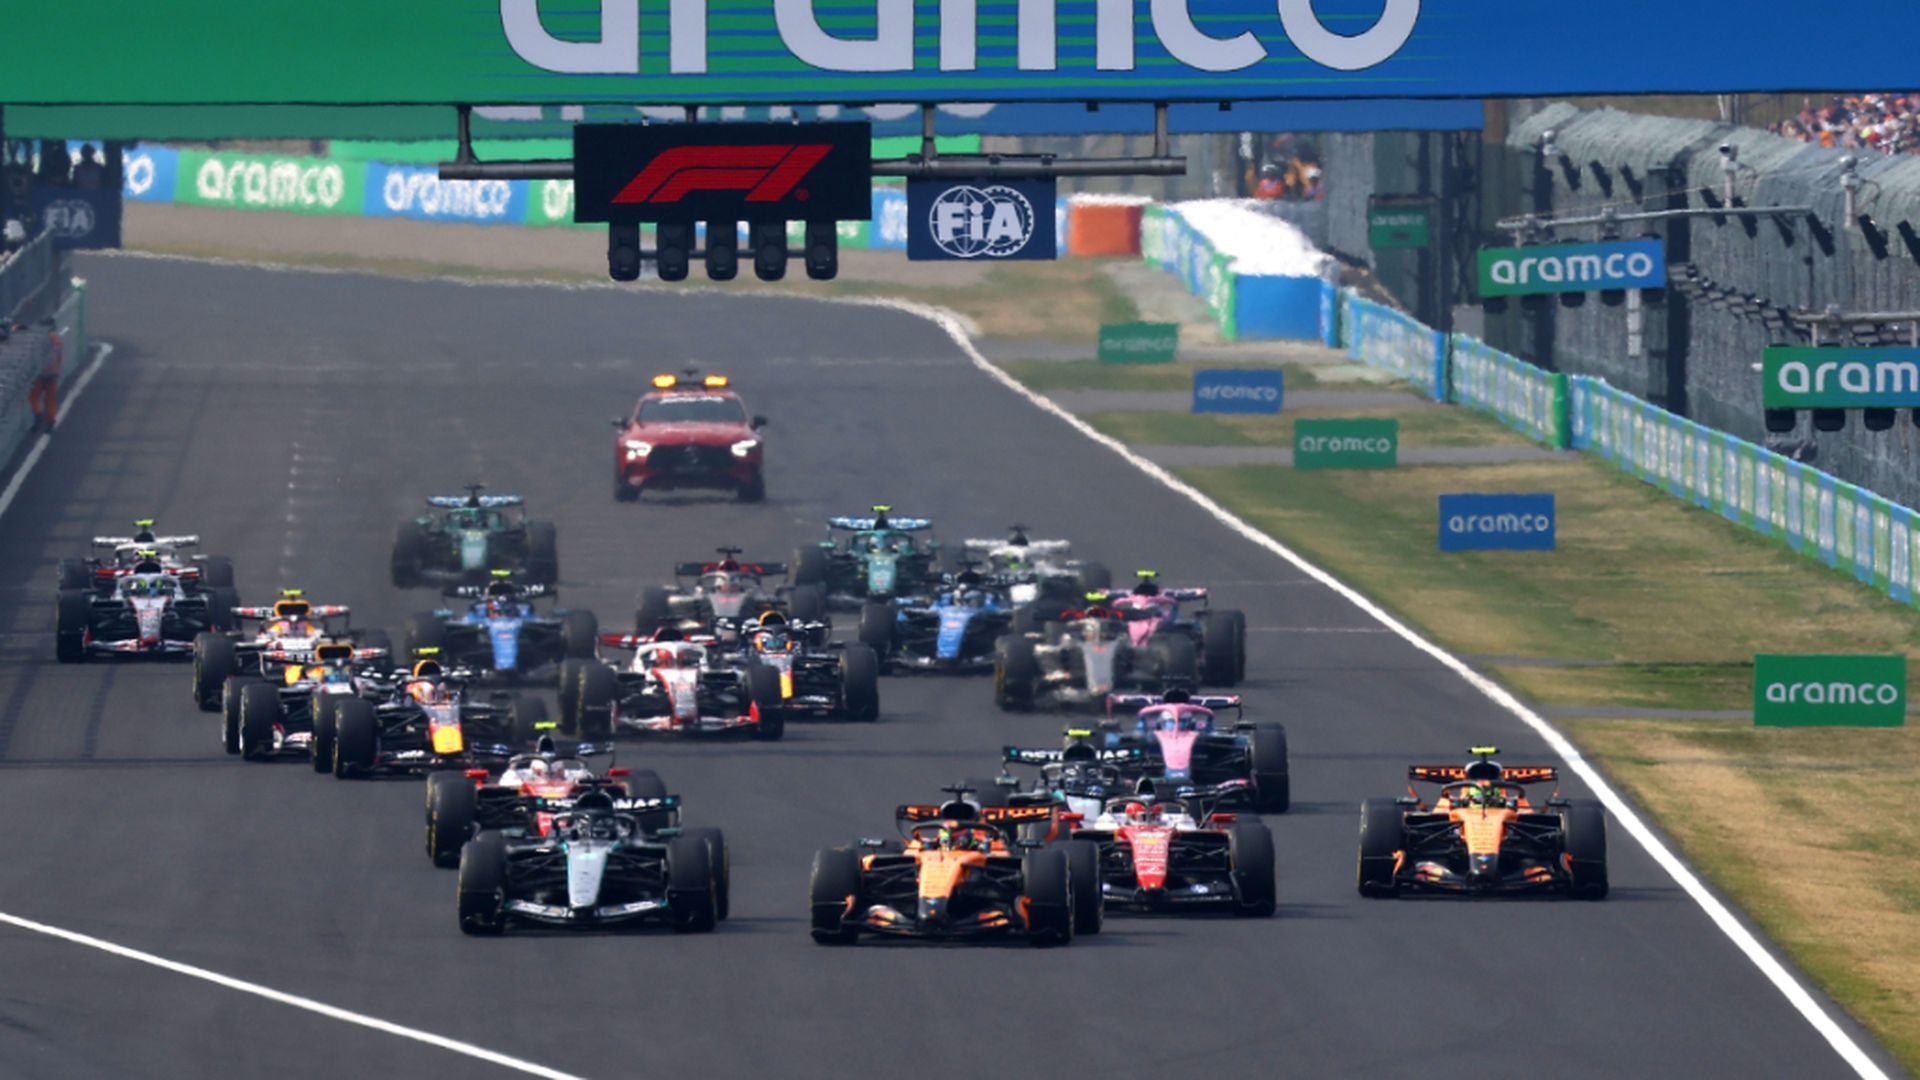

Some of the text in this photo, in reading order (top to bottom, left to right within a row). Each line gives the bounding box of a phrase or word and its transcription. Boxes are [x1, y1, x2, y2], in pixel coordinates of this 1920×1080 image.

[197, 158, 344, 208] aramco
[383, 171, 512, 218] aramco
[1490, 252, 1654, 285] aramco
[1778, 361, 1920, 393] aram
[1198, 385, 1279, 401] aramco
[1299, 435, 1392, 454] aramco
[1448, 512, 1550, 534] aramco
[1765, 681, 1899, 705] aramco
